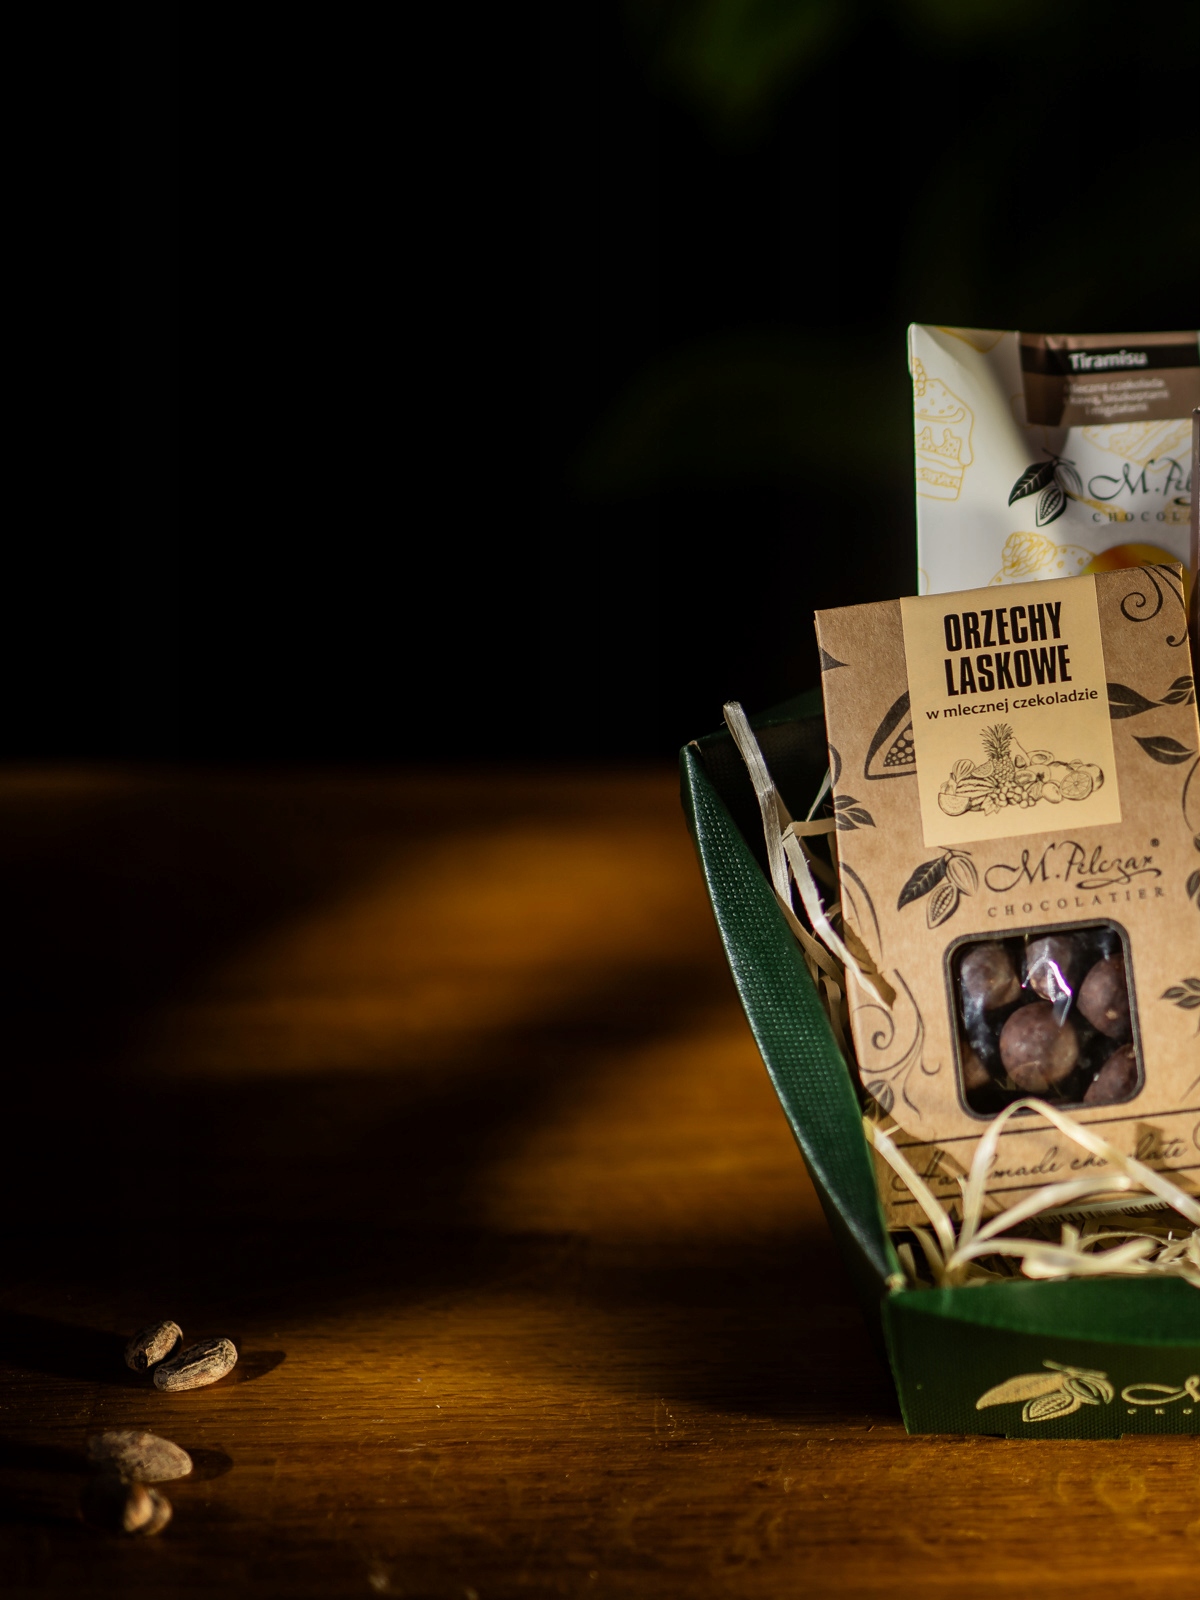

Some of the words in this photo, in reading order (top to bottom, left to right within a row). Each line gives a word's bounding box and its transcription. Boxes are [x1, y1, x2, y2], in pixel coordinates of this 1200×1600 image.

[1069, 350, 1148, 370] Tiramisu
[1092, 511, 1192, 523] CHOCOL
[943, 601, 1062, 652] ORZECHY
[944, 644, 1072, 696] LASKOWE
[926, 710, 940, 720] w
[943, 698, 1009, 718] mlecznej
[1012, 688, 1099, 709] czekoladzie
[987, 886, 1165, 918] CHOCOLATIER
